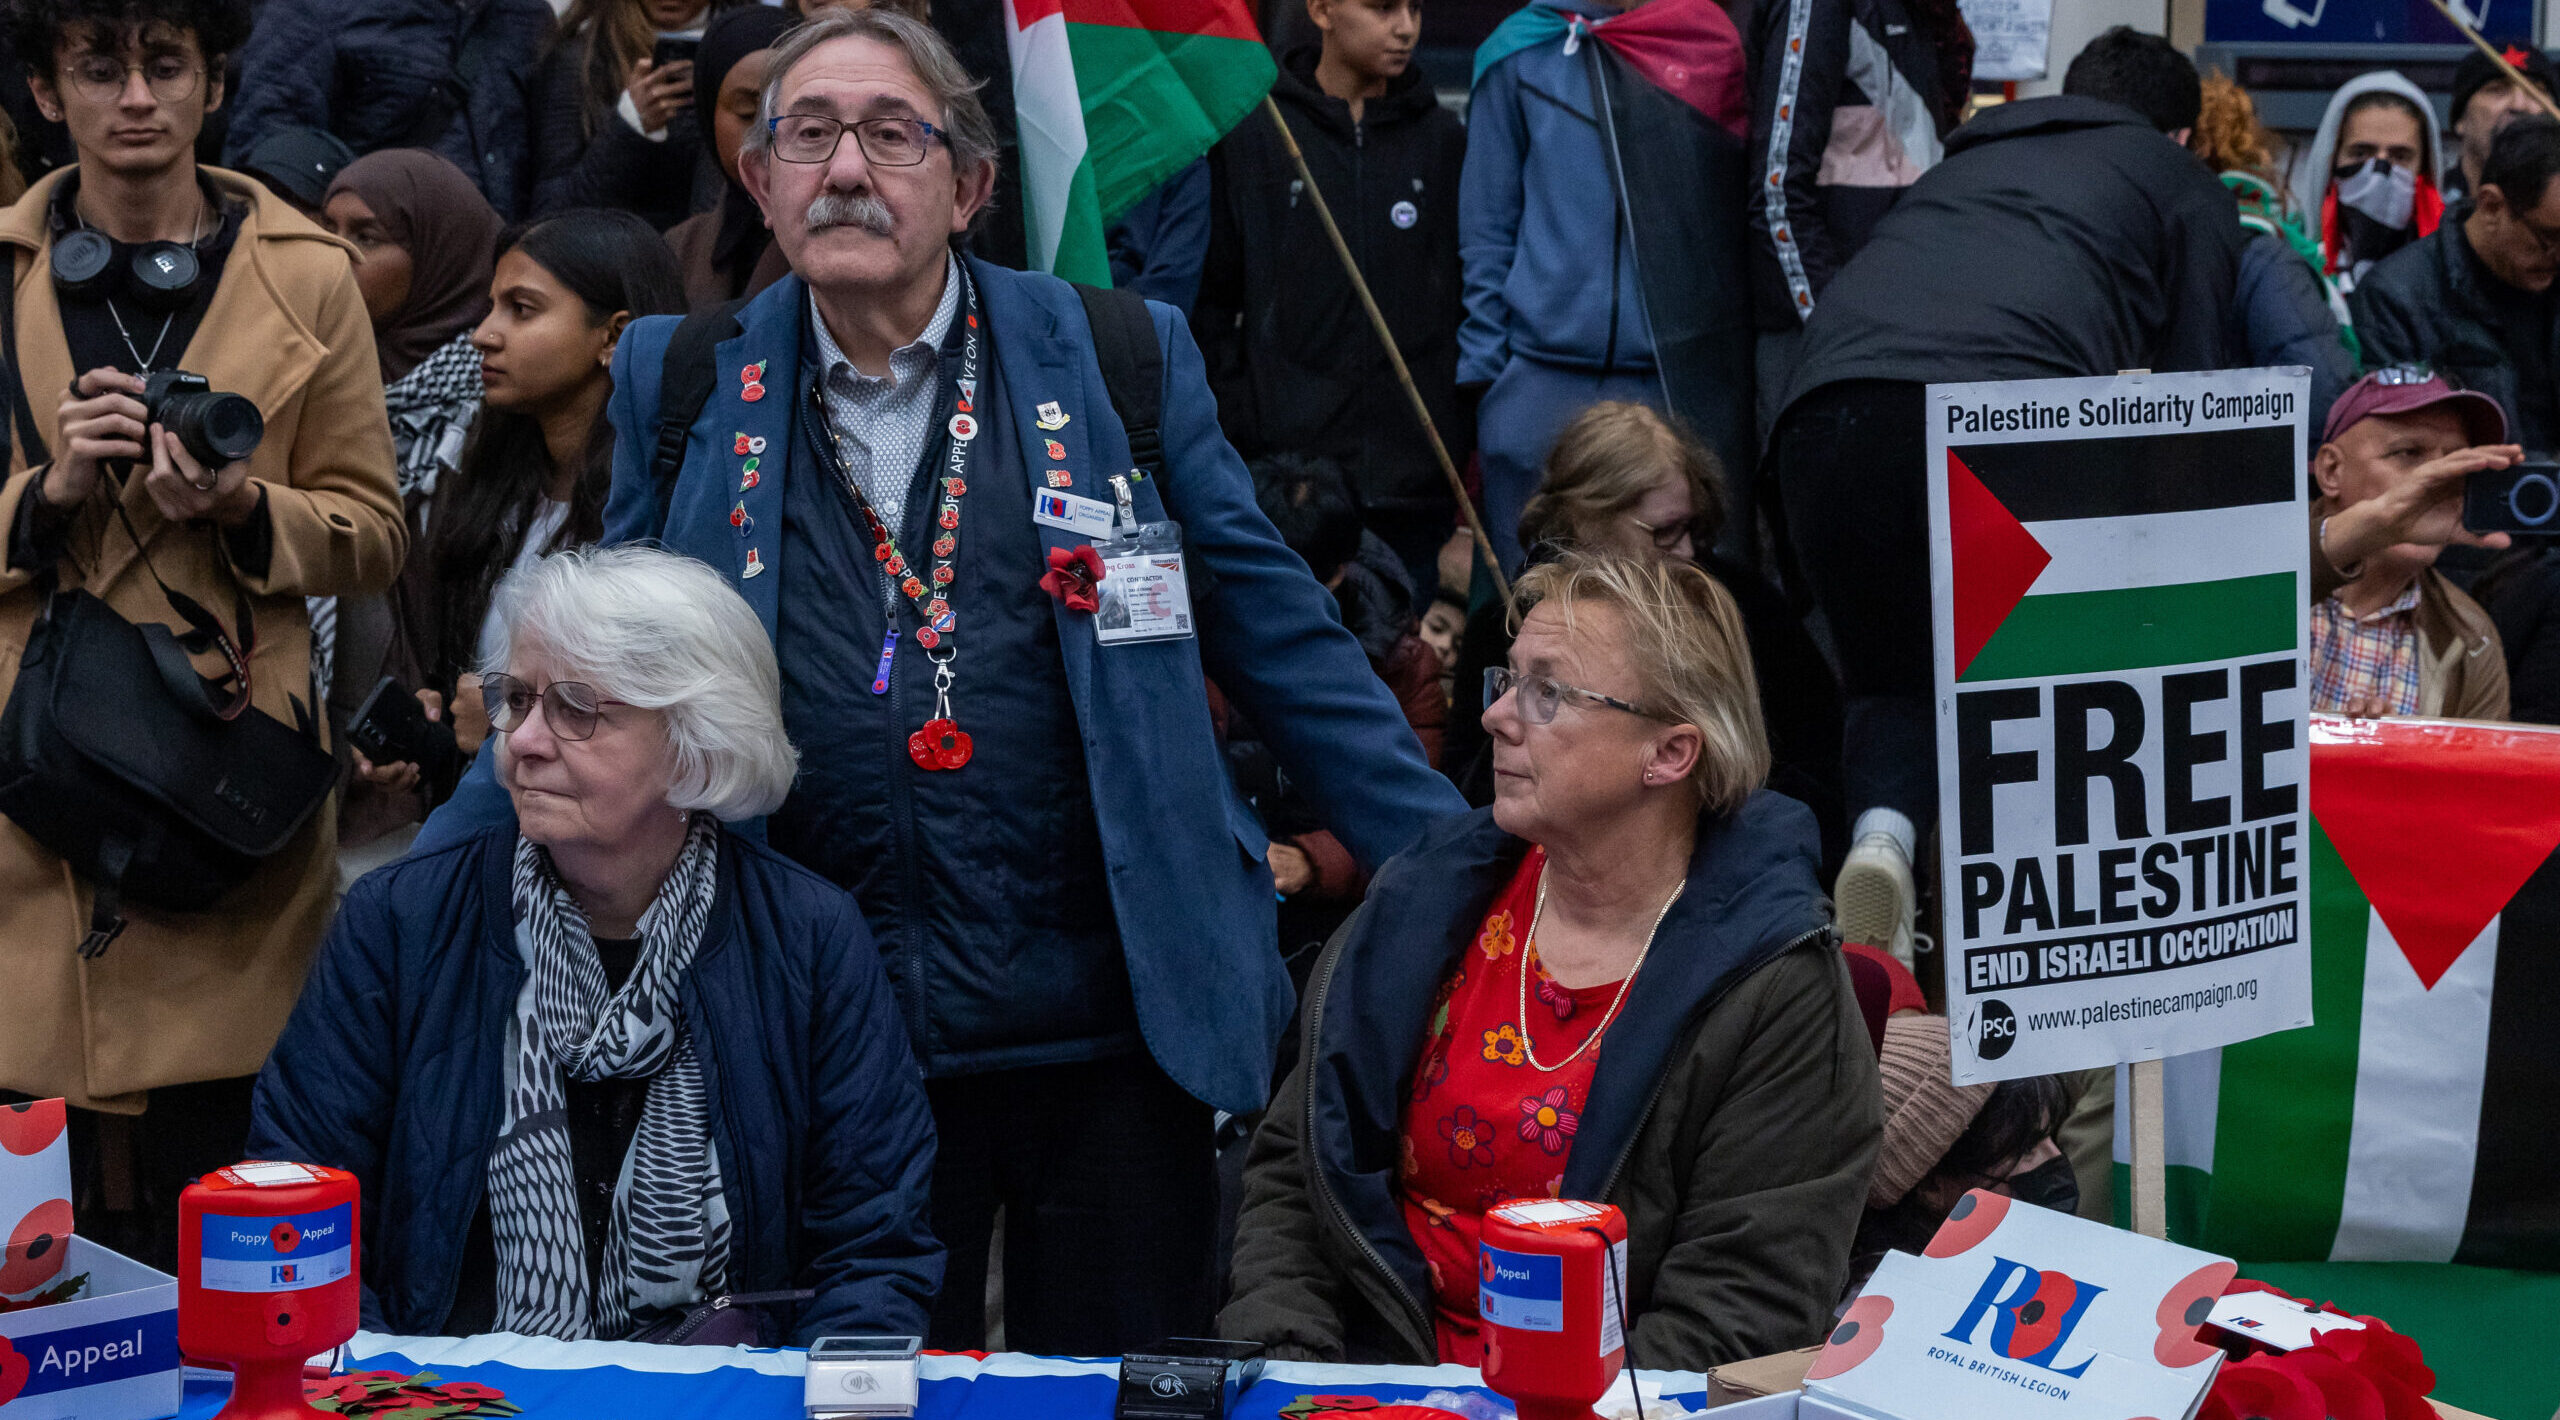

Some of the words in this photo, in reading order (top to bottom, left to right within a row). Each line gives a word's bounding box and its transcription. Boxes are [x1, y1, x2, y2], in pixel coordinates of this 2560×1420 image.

[1948, 401, 2070, 433] Palestine
[2079, 396, 2195, 427] Solidarity
[2203, 388, 2294, 423] Campaign
[950, 440, 968, 474] APPE
[1126, 575, 1163, 584] CONTRACTOR
[1956, 658, 2298, 857] FREE
[1960, 820, 2297, 940] PALESTINE
[1970, 951, 2029, 988] END
[2039, 936, 2151, 979] ISRAELI
[2159, 909, 2294, 964] OCCUPATION
[2028, 978, 2258, 1031] www.palestinecampaign.org
[1983, 1016, 2015, 1040] PSC
[231, 1231, 268, 1246] Poppy
[302, 1222, 335, 1241] Appeal
[1496, 1264, 1530, 1281] Appeal
[38, 1329, 143, 1377] Appeal
[1927, 1346, 1965, 1368] ROYAL
[1968, 1360, 2021, 1384] BRITISH
[2020, 1376, 2070, 1401] LEGION
